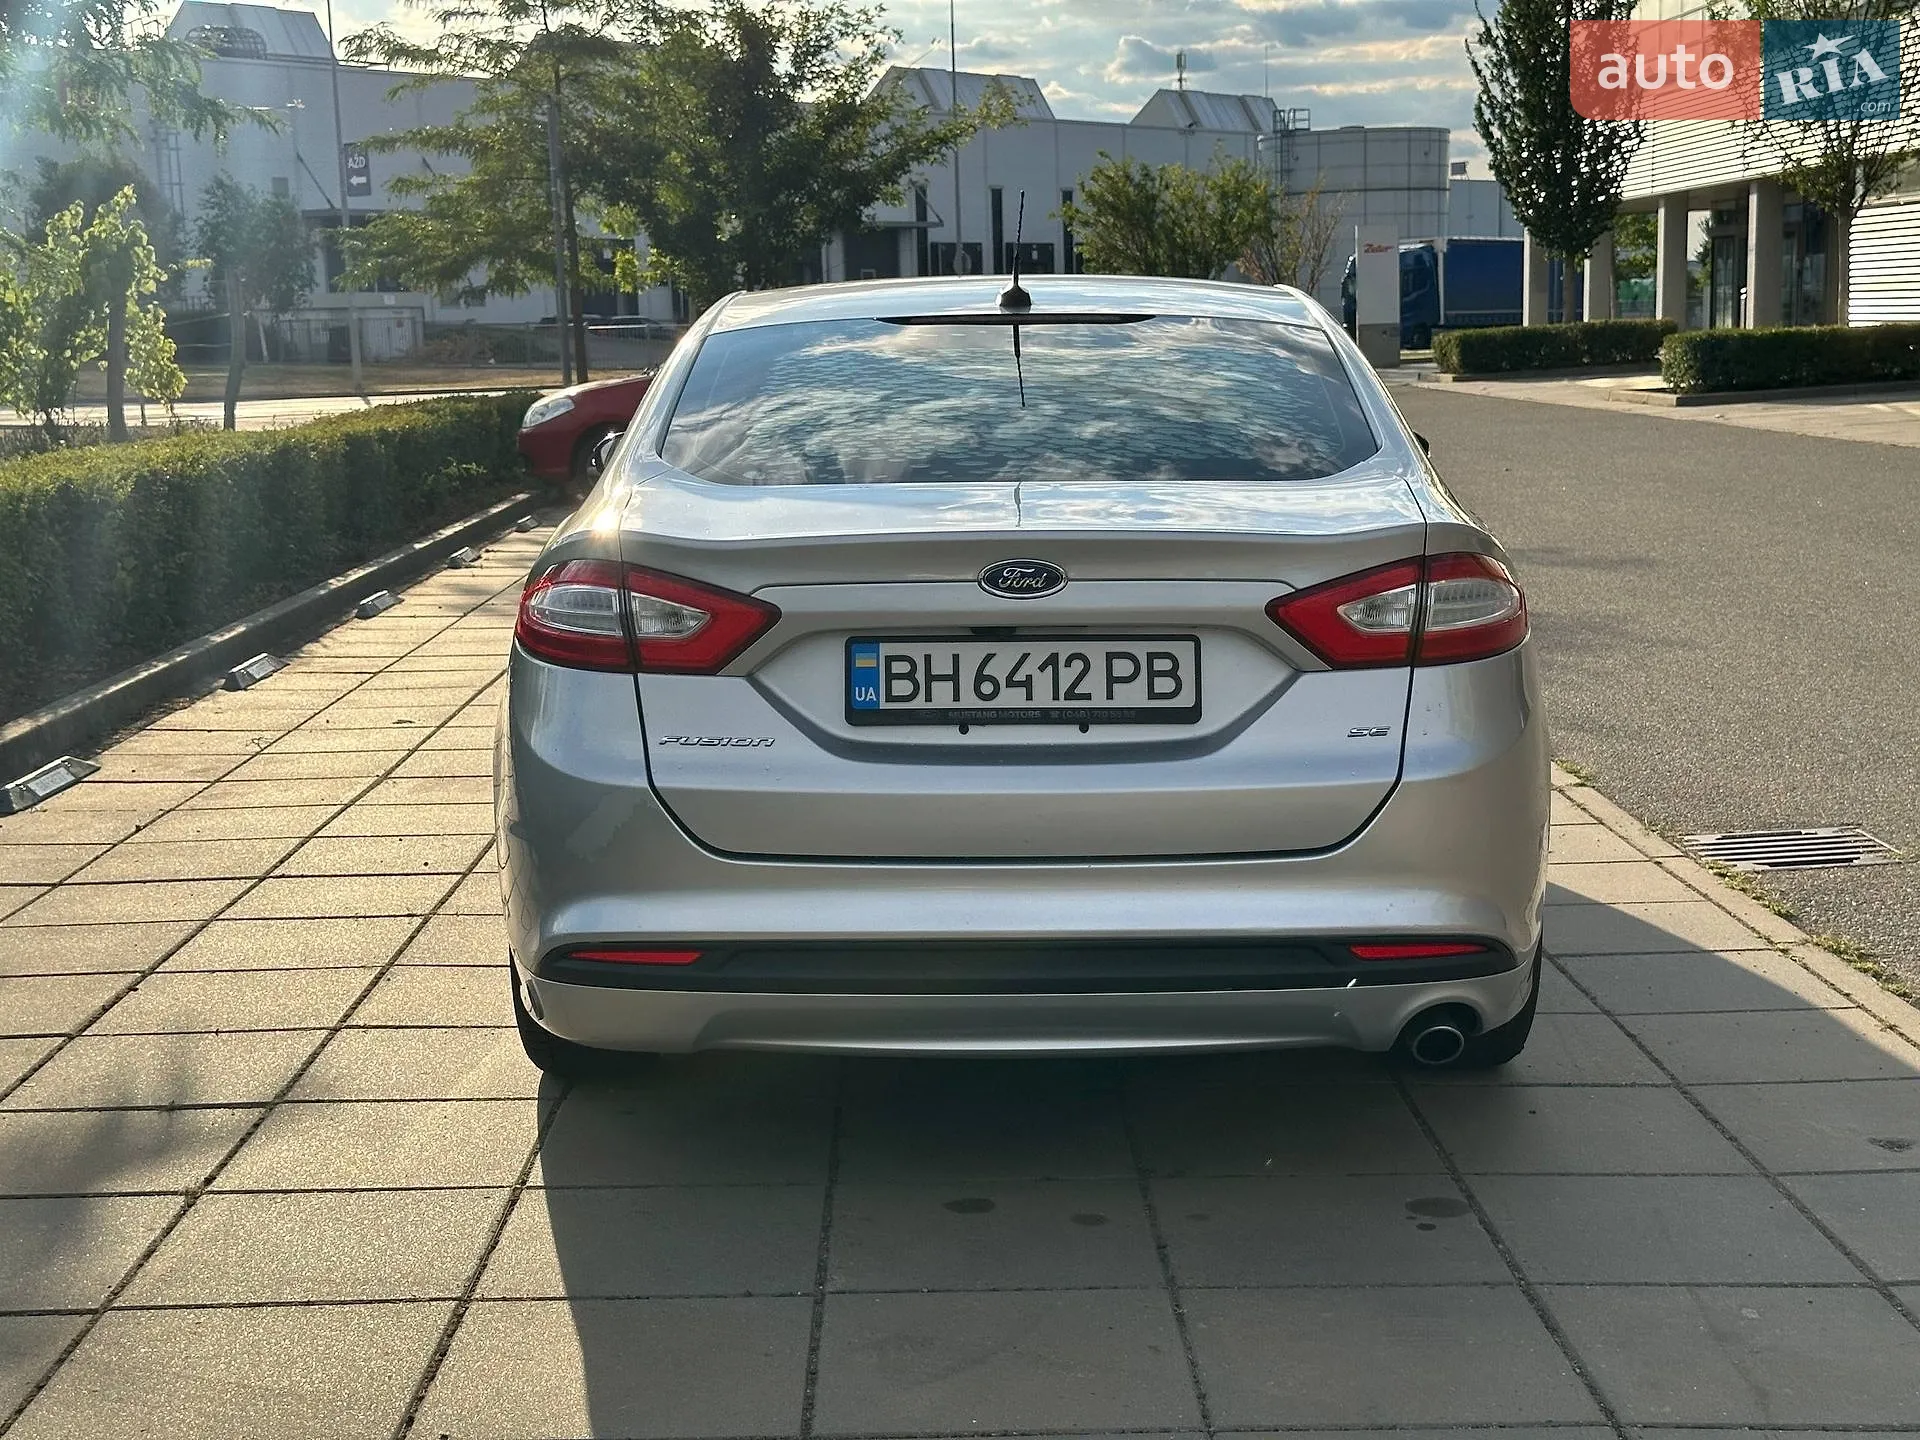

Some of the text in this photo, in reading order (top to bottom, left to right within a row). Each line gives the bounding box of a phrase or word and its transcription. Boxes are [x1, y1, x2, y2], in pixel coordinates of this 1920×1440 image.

[998, 567, 1048, 589] Ford
[884, 651, 1183, 703] BH 6412 PB
[855, 686, 877, 701] UA
[1347, 725, 1391, 738] SE
[658, 735, 775, 747] FUSION
